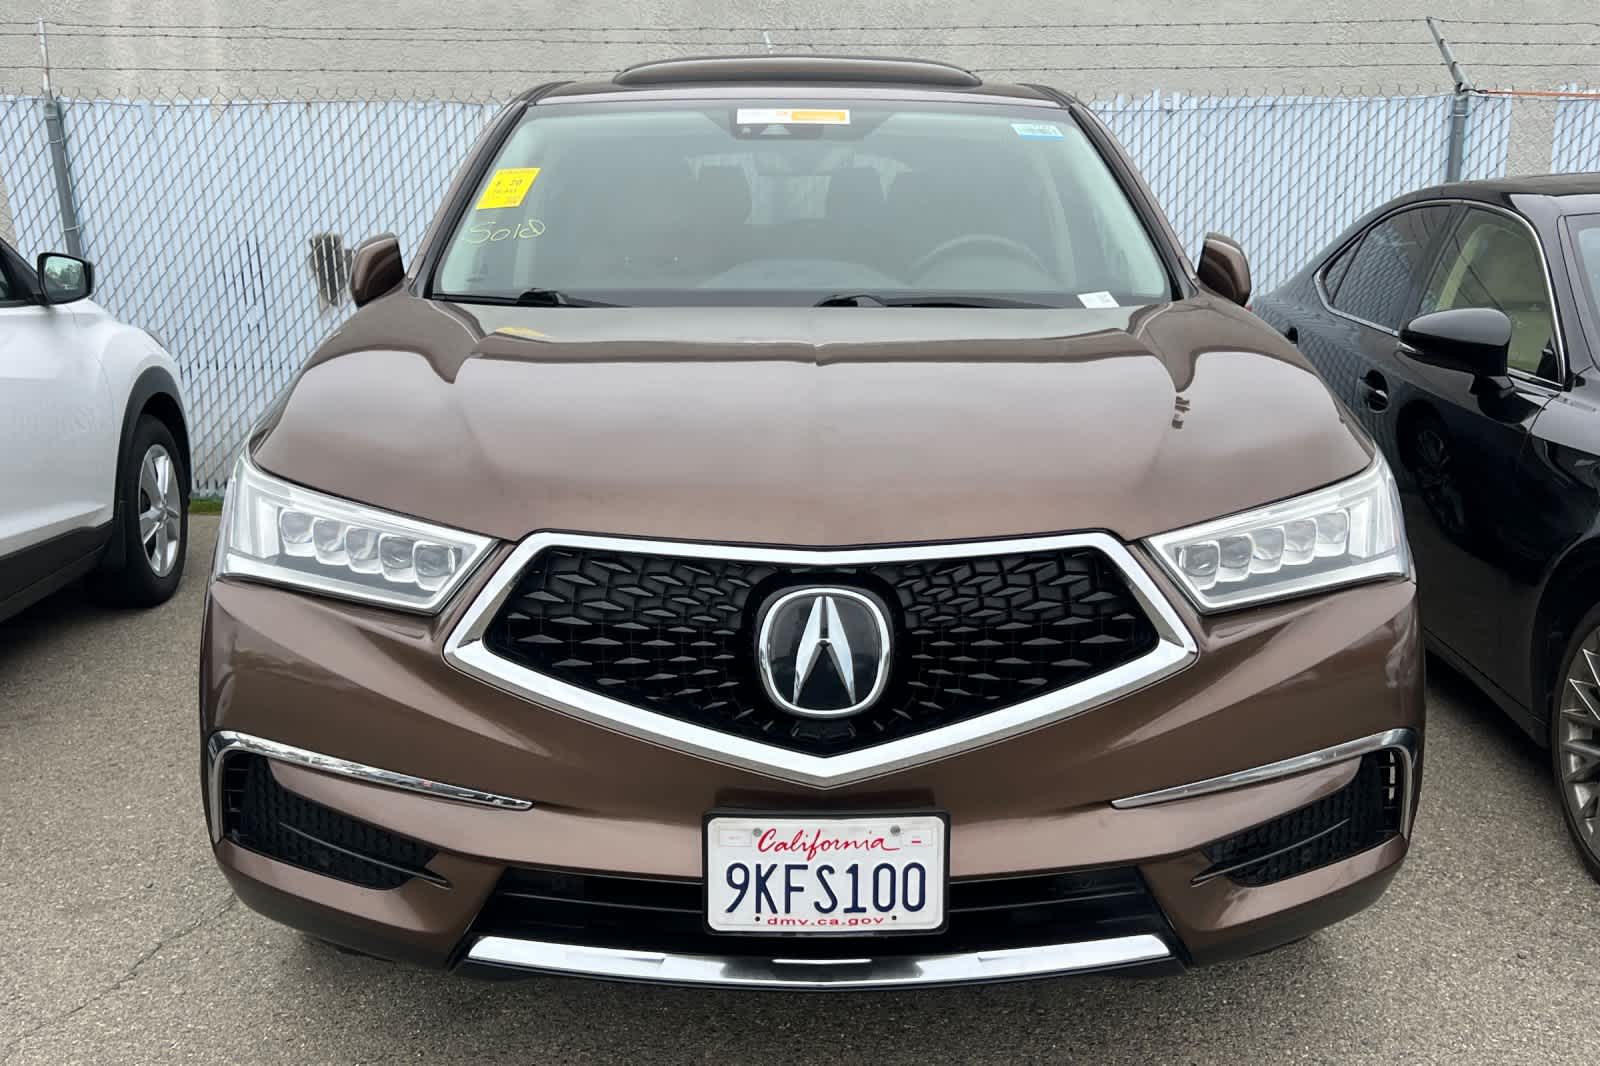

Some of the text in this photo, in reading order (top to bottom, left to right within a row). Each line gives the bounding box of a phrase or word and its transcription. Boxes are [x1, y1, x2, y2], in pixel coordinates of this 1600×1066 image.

[757, 828, 900, 861] California
[725, 862, 926, 914] 9KFS100
[767, 916, 884, 927] dmv.ca.gov
